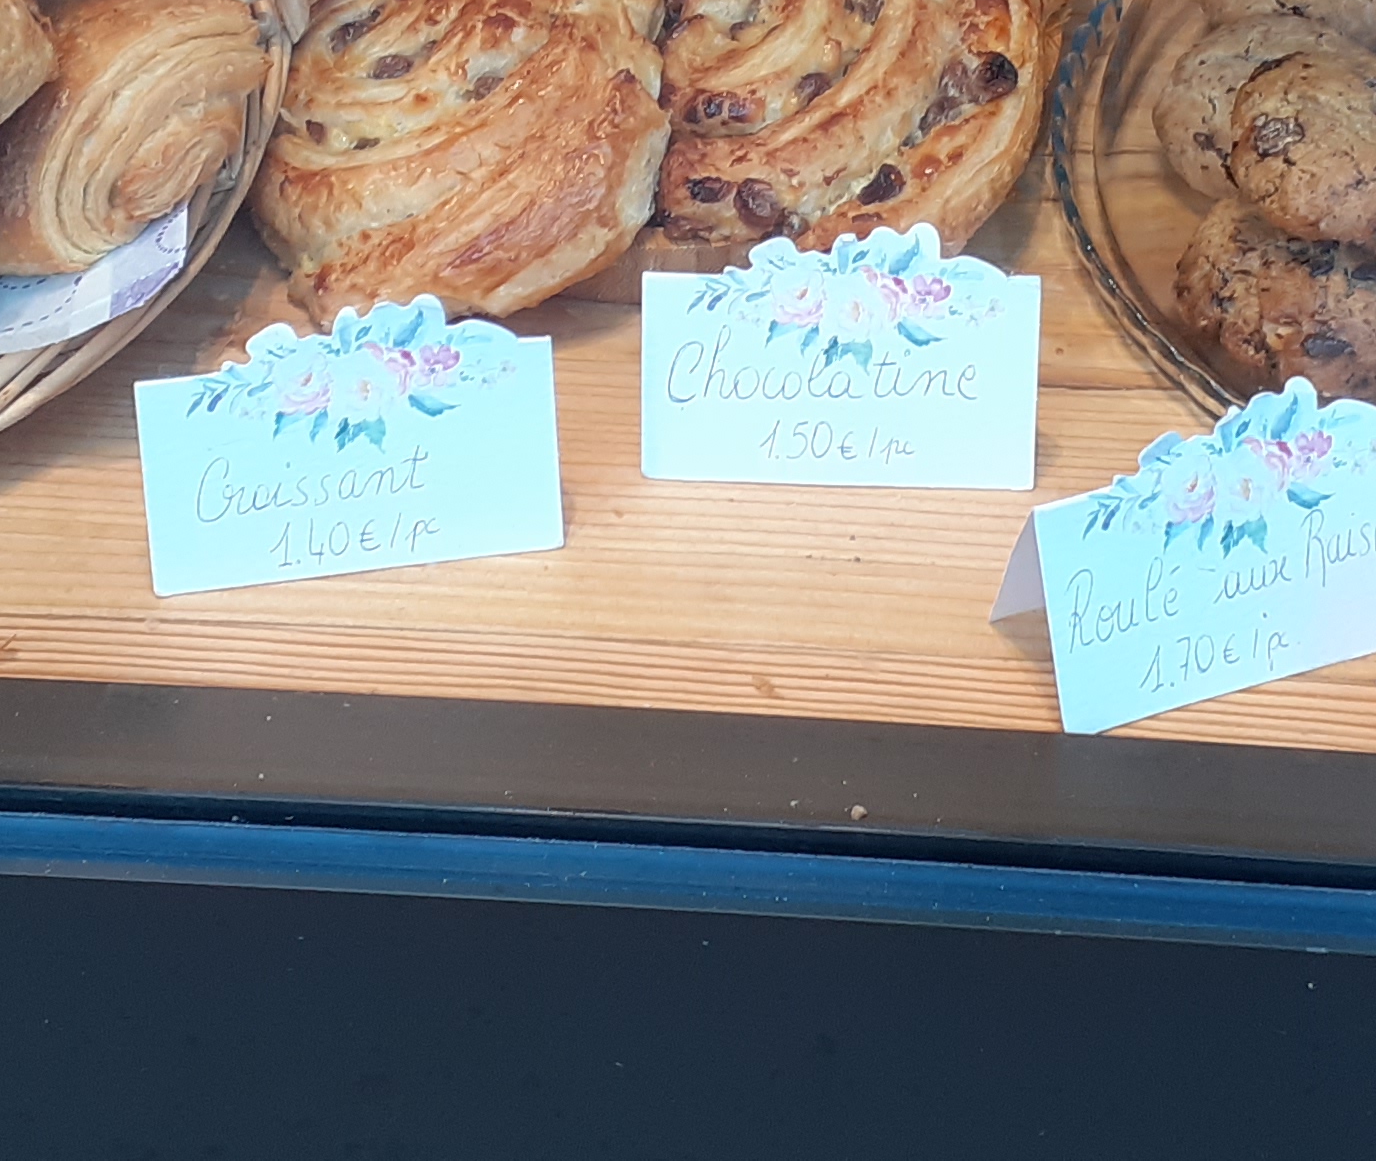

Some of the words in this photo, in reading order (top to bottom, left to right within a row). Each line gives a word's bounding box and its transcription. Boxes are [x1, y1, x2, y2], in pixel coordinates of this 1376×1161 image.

[667, 325, 978, 403] Chocolatine
[197, 445, 429, 523] Croissant
[1064, 557, 1180, 654] Roulé
[1213, 556, 1291, 604] aux
